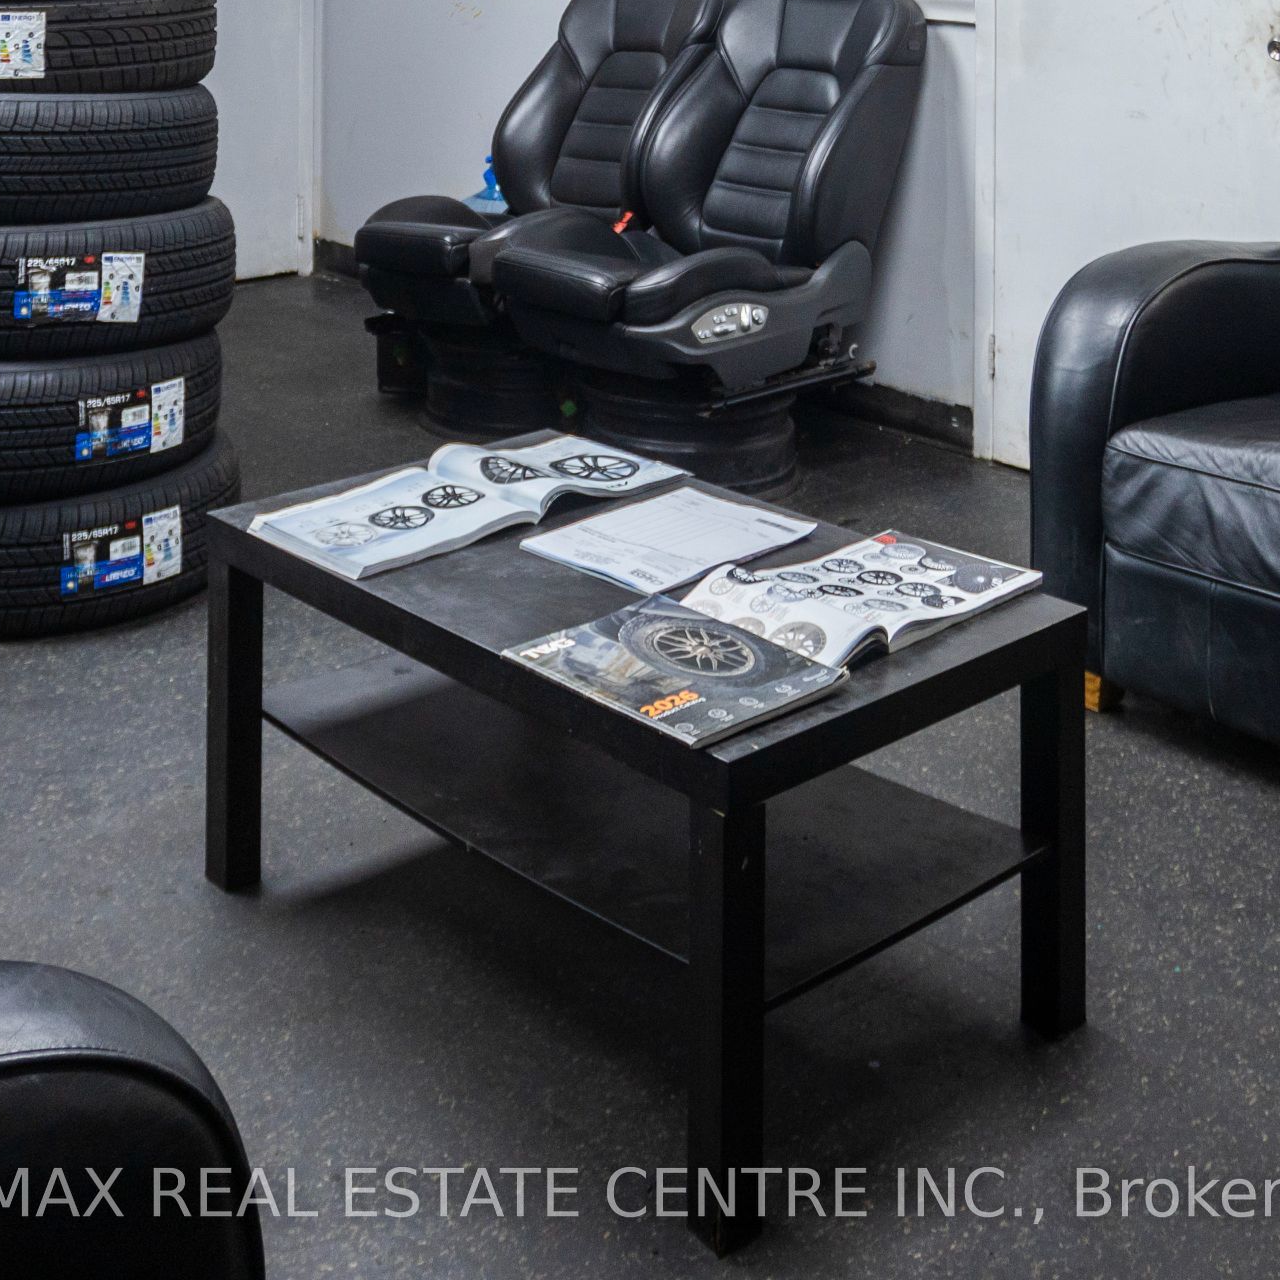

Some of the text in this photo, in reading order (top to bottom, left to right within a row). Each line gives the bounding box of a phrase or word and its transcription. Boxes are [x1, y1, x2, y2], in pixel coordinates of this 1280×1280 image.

[87, 393, 131, 409] 225/65R17
[71, 523, 119, 541] 225/65R17
[640, 690, 699, 717] 2026
